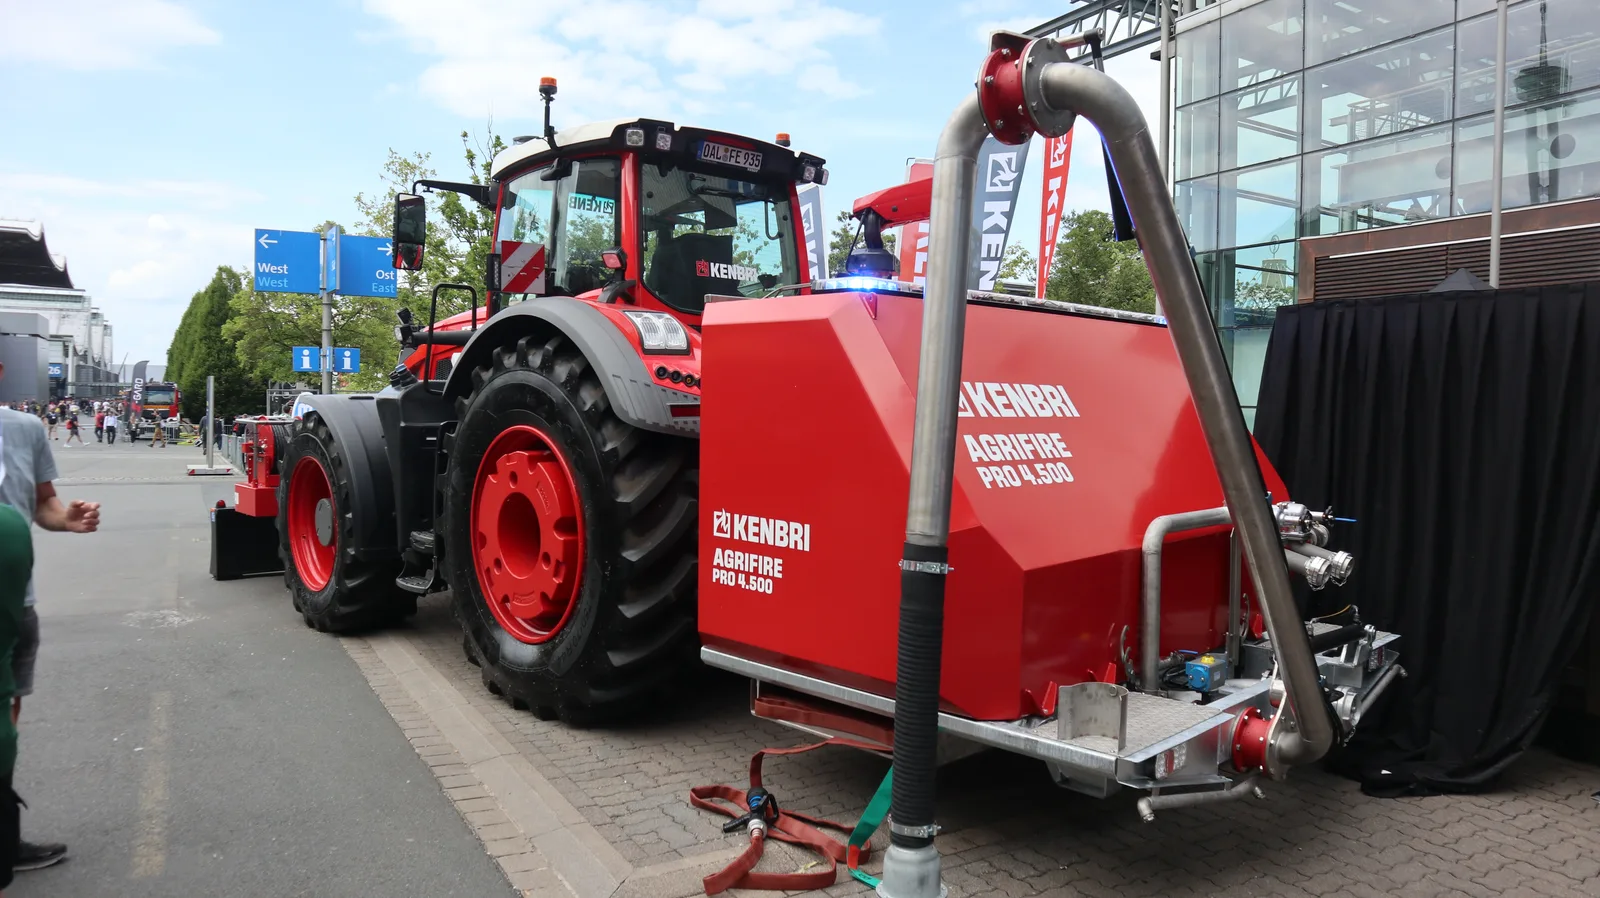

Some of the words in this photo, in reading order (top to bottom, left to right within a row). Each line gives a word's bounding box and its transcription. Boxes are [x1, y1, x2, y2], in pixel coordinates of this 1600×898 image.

[703, 143, 722, 161] OAL
[728, 150, 741, 165] FE
[743, 154, 762, 169] 935
[257, 262, 289, 275] West
[375, 269, 395, 281] Ost
[257, 276, 289, 289] West
[371, 282, 396, 294] East
[49, 366, 61, 375] 26
[962, 381, 1081, 418] KENBRI
[963, 432, 1073, 463] AGRIFIRE
[976, 464, 1023, 489] PRO
[1017, 461, 1075, 485] 4.500
[733, 513, 811, 552] KENBRI
[713, 547, 783, 579] AGRIFIRE
[712, 567, 736, 587] PRO
[737, 572, 773, 595] 4.500
